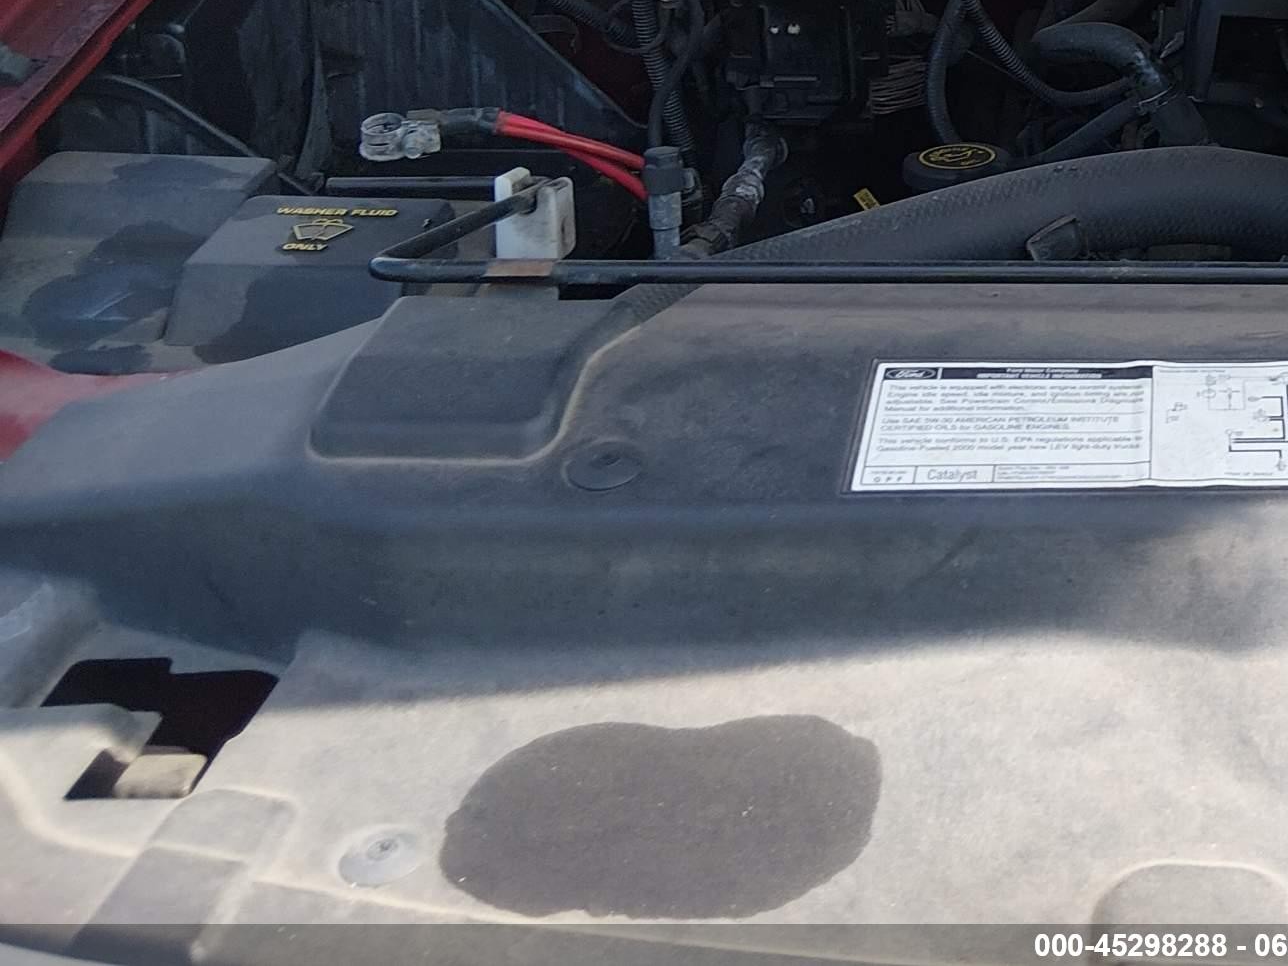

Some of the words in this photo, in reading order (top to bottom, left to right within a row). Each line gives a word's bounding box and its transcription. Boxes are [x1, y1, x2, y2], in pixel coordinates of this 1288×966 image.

[276, 207, 348, 217] WASHER
[350, 208, 399, 218] FLUID
[282, 242, 329, 252] ONLY
[894, 369, 926, 378] Ford
[927, 469, 978, 483] Catalyst
